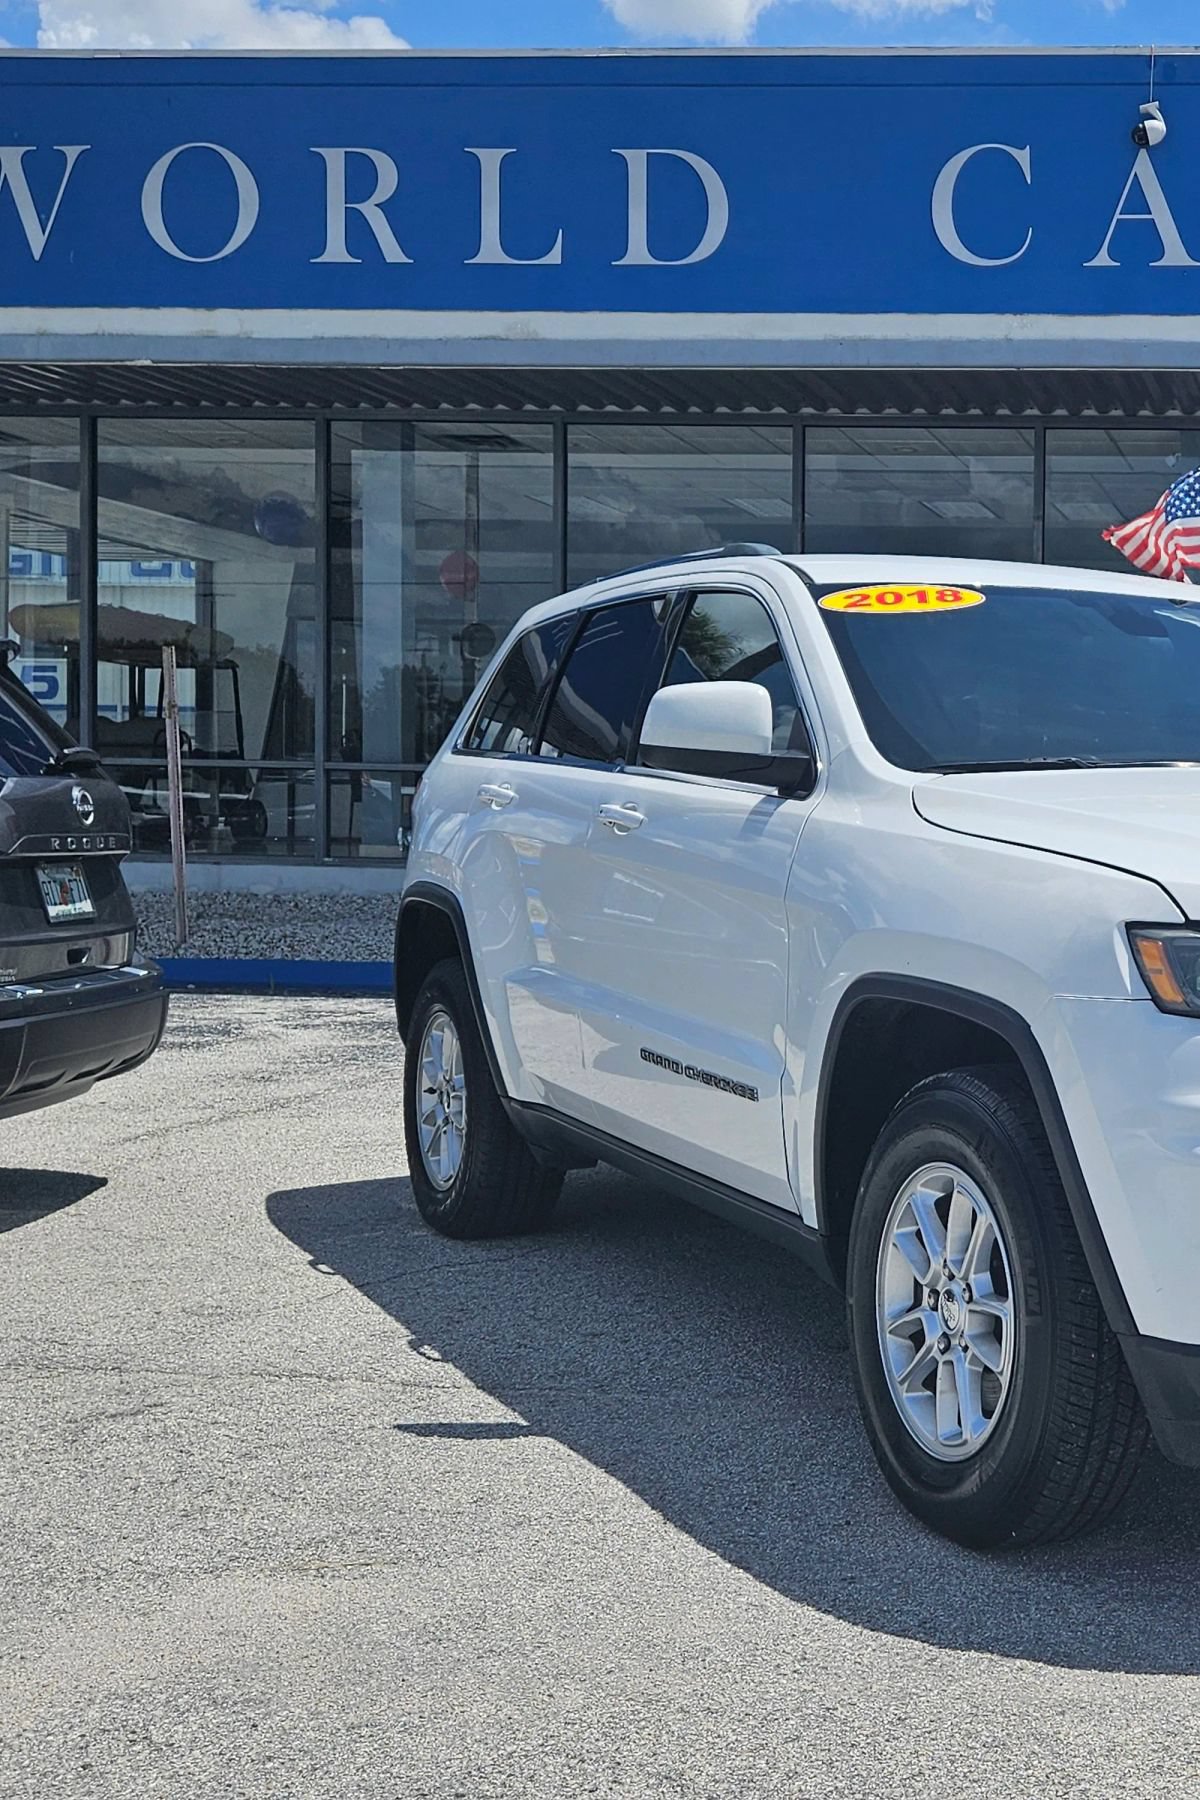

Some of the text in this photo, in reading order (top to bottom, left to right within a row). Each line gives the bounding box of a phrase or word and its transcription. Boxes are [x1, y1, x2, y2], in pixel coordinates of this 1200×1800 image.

[0, 142, 730, 266] WORLD
[843, 588, 964, 609] 2018
[50, 836, 117, 851] ROGUE
[640, 1046, 760, 1103] GRAND CHEROKEE
